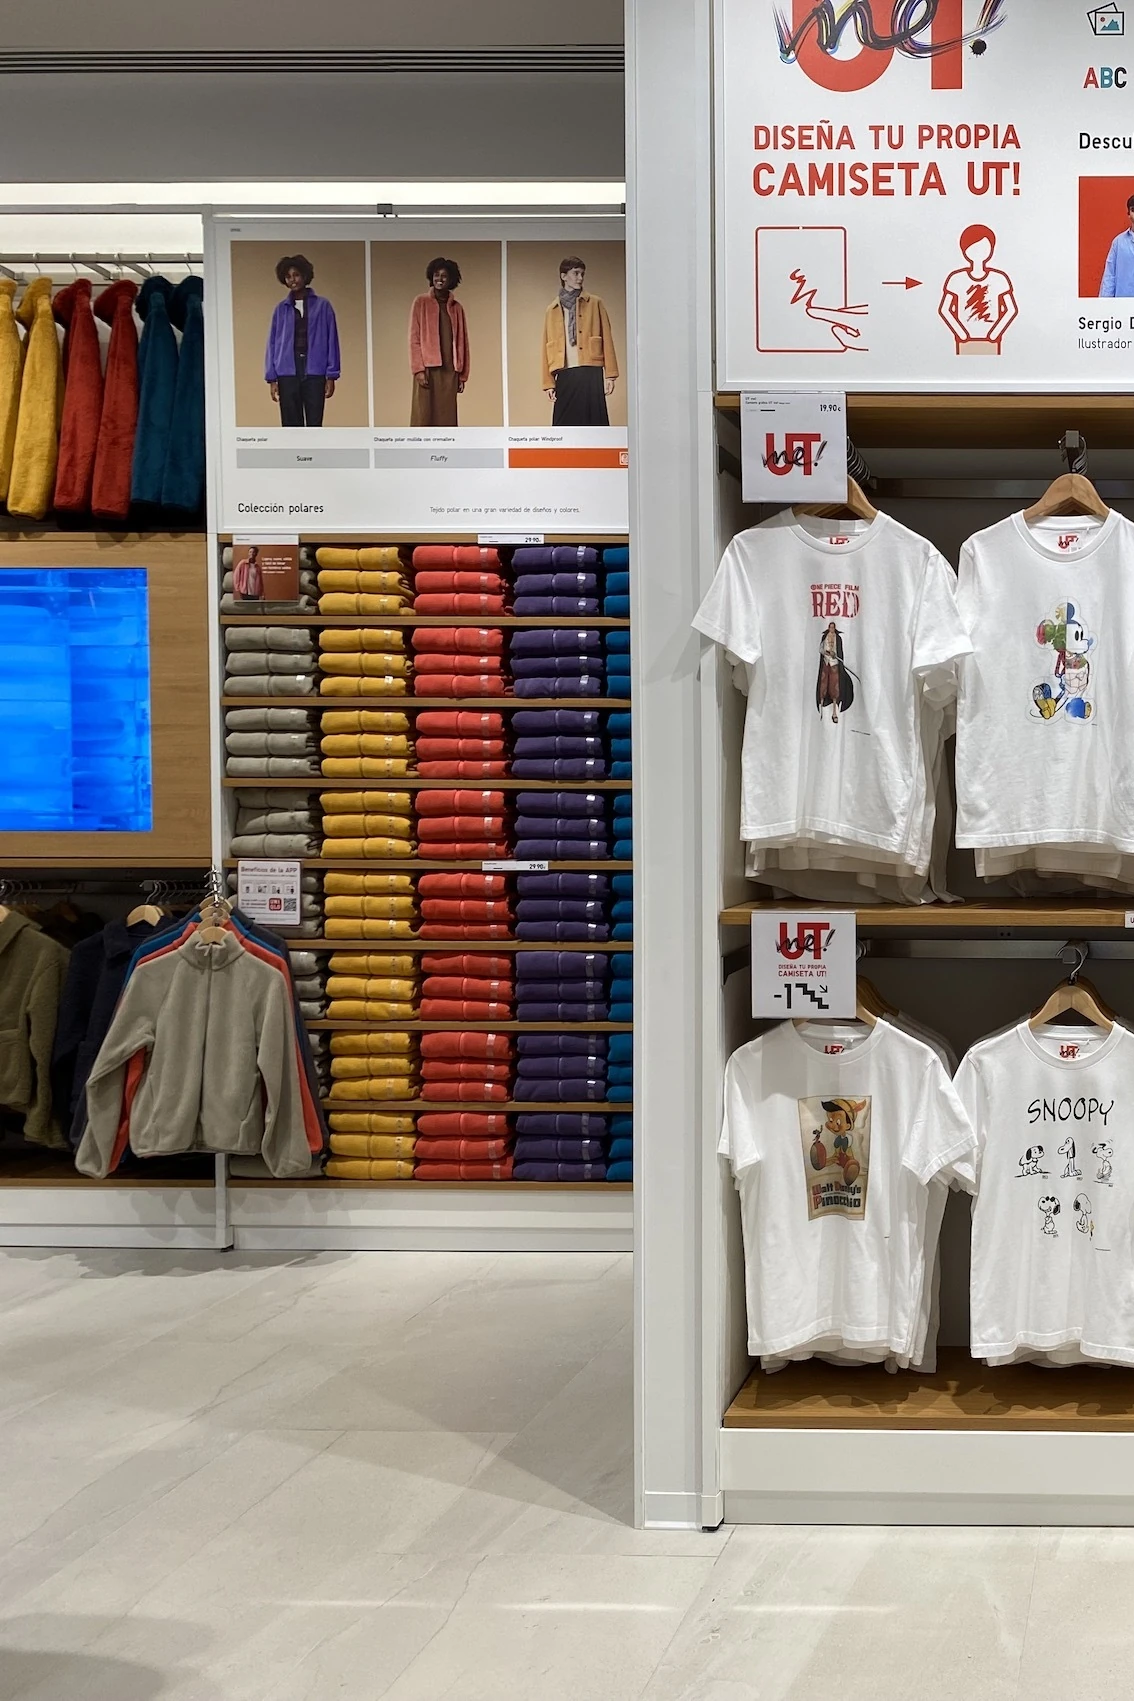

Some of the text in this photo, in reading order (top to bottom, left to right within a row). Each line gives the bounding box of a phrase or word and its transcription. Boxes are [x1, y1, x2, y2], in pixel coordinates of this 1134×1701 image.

[1082, 66, 1128, 90] ABC
[754, 119, 1022, 151] DISEÑA TU PROPIA
[752, 161, 1021, 197] CAMISETA UT!
[1078, 316, 1122, 334] Sergio
[430, 455, 448, 463] Fluffy
[237, 502, 324, 516] Colección polares
[429, 506, 446, 514] Tejido
[446, 506, 461, 514] polar
[810, 583, 823, 591] ONE
[810, 590, 860, 619] RED
[816, 970, 827, 978] UT!
[1027, 1097, 1114, 1126] SNOOPY
